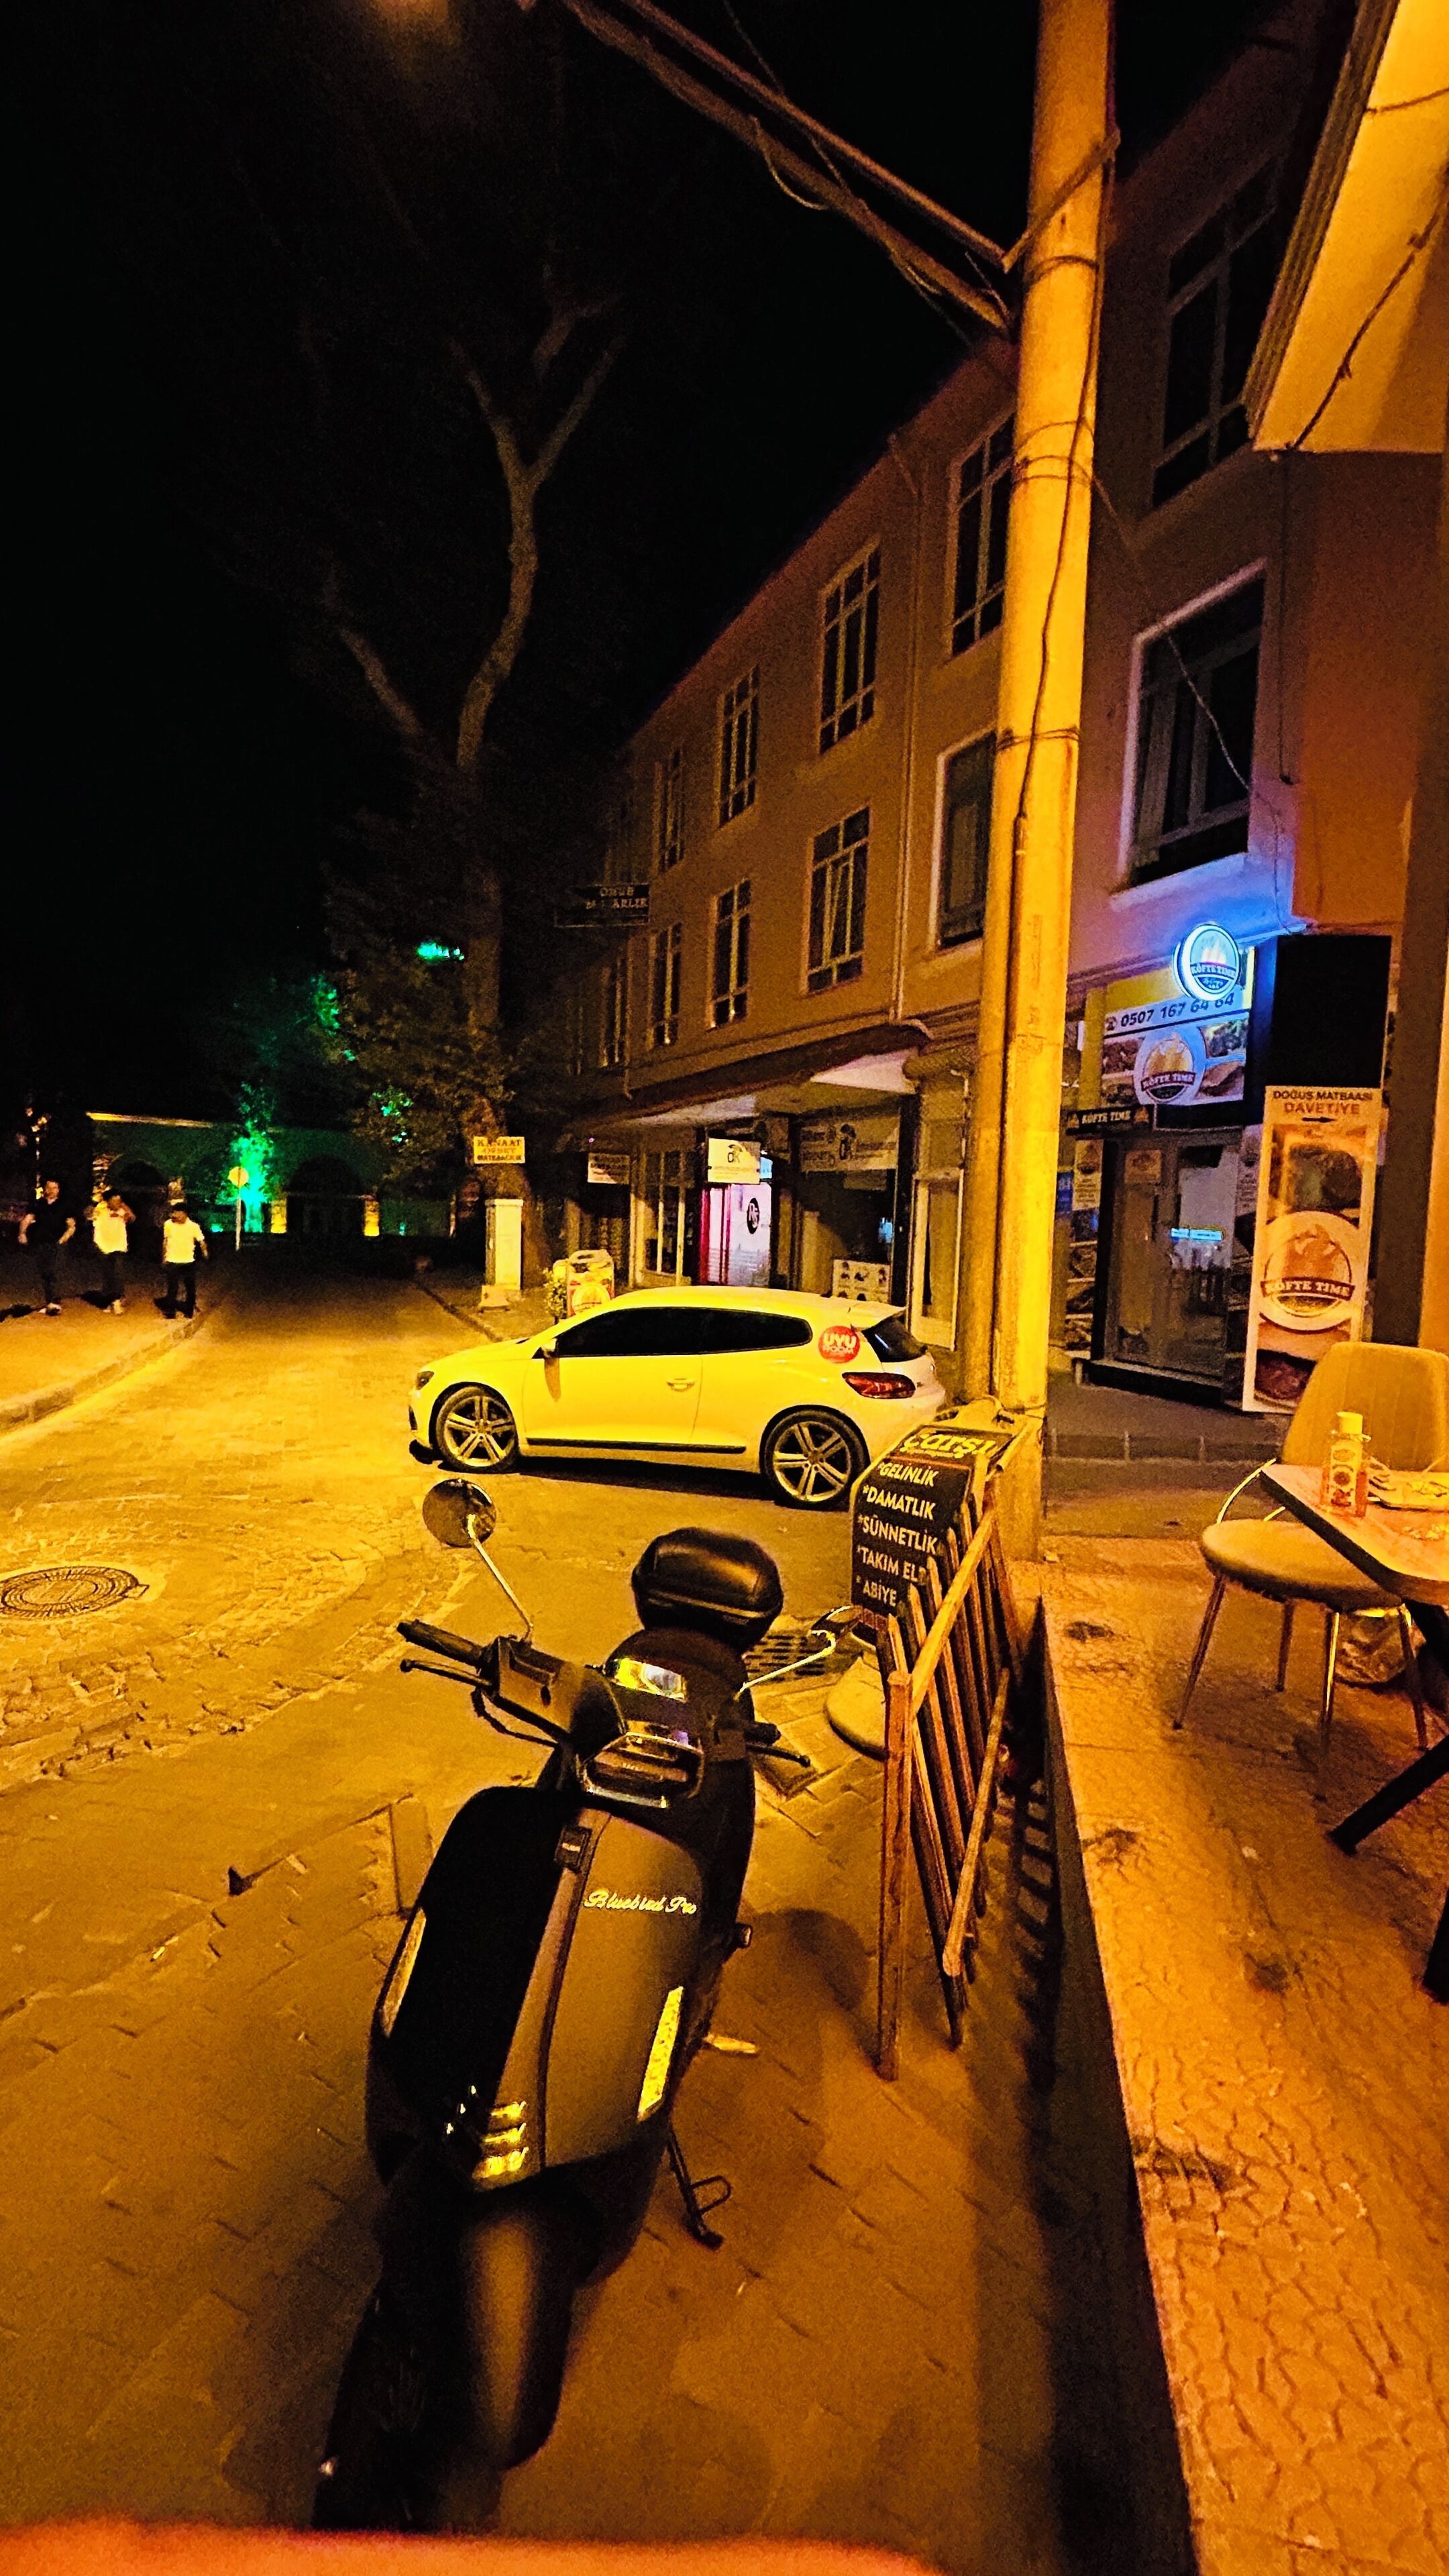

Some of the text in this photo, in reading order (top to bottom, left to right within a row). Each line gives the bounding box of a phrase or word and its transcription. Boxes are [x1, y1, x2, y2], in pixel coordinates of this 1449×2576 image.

[1120, 1010, 1154, 1027] 0507
[1161, 1001, 1186, 1018] 167
[1315, 1282, 1350, 1296] TIME
[665, 1896, 697, 1915] Pro
